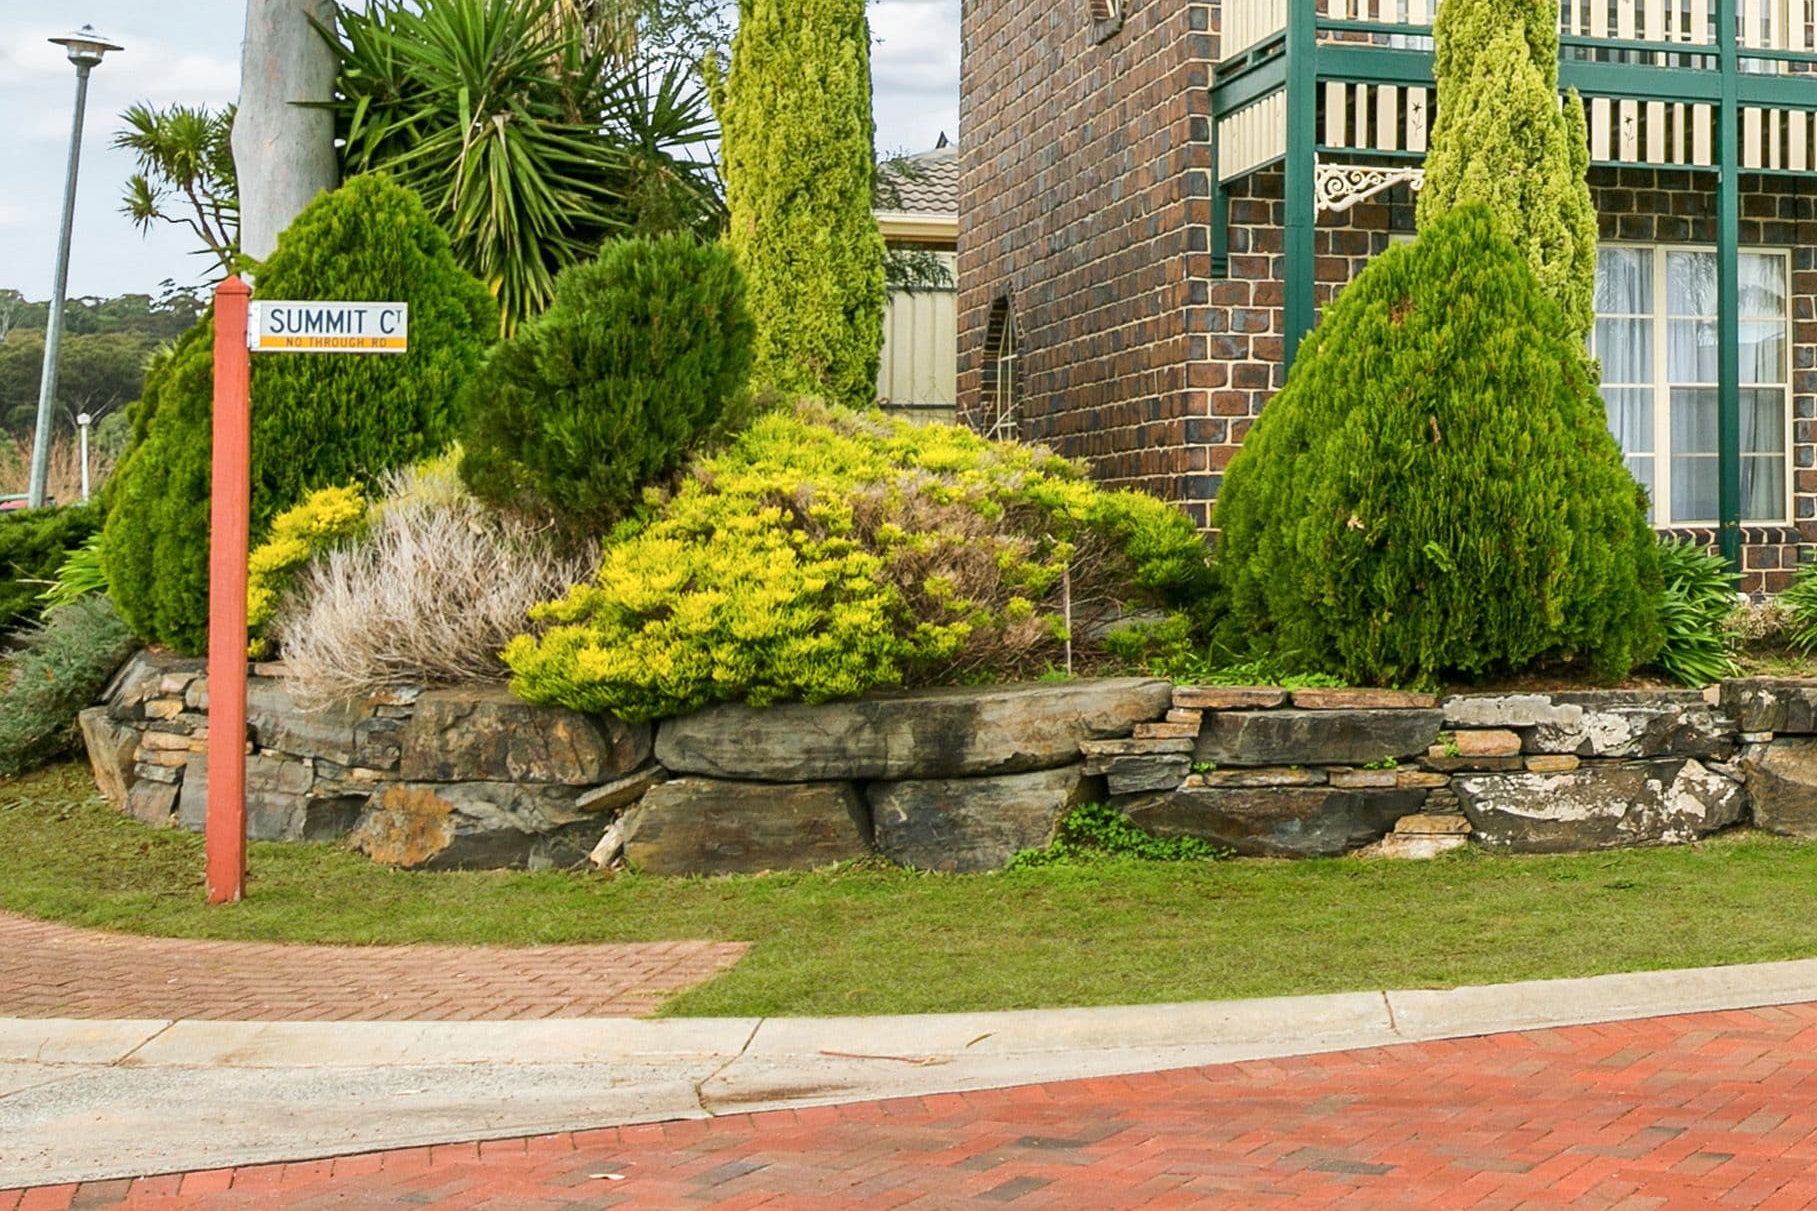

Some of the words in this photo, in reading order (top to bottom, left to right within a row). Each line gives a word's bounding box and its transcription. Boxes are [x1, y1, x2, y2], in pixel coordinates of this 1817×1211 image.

[269, 308, 368, 334] SUMMIT
[286, 337, 303, 347] NO
[308, 337, 364, 347] THROUGH
[372, 337, 387, 347] RD
